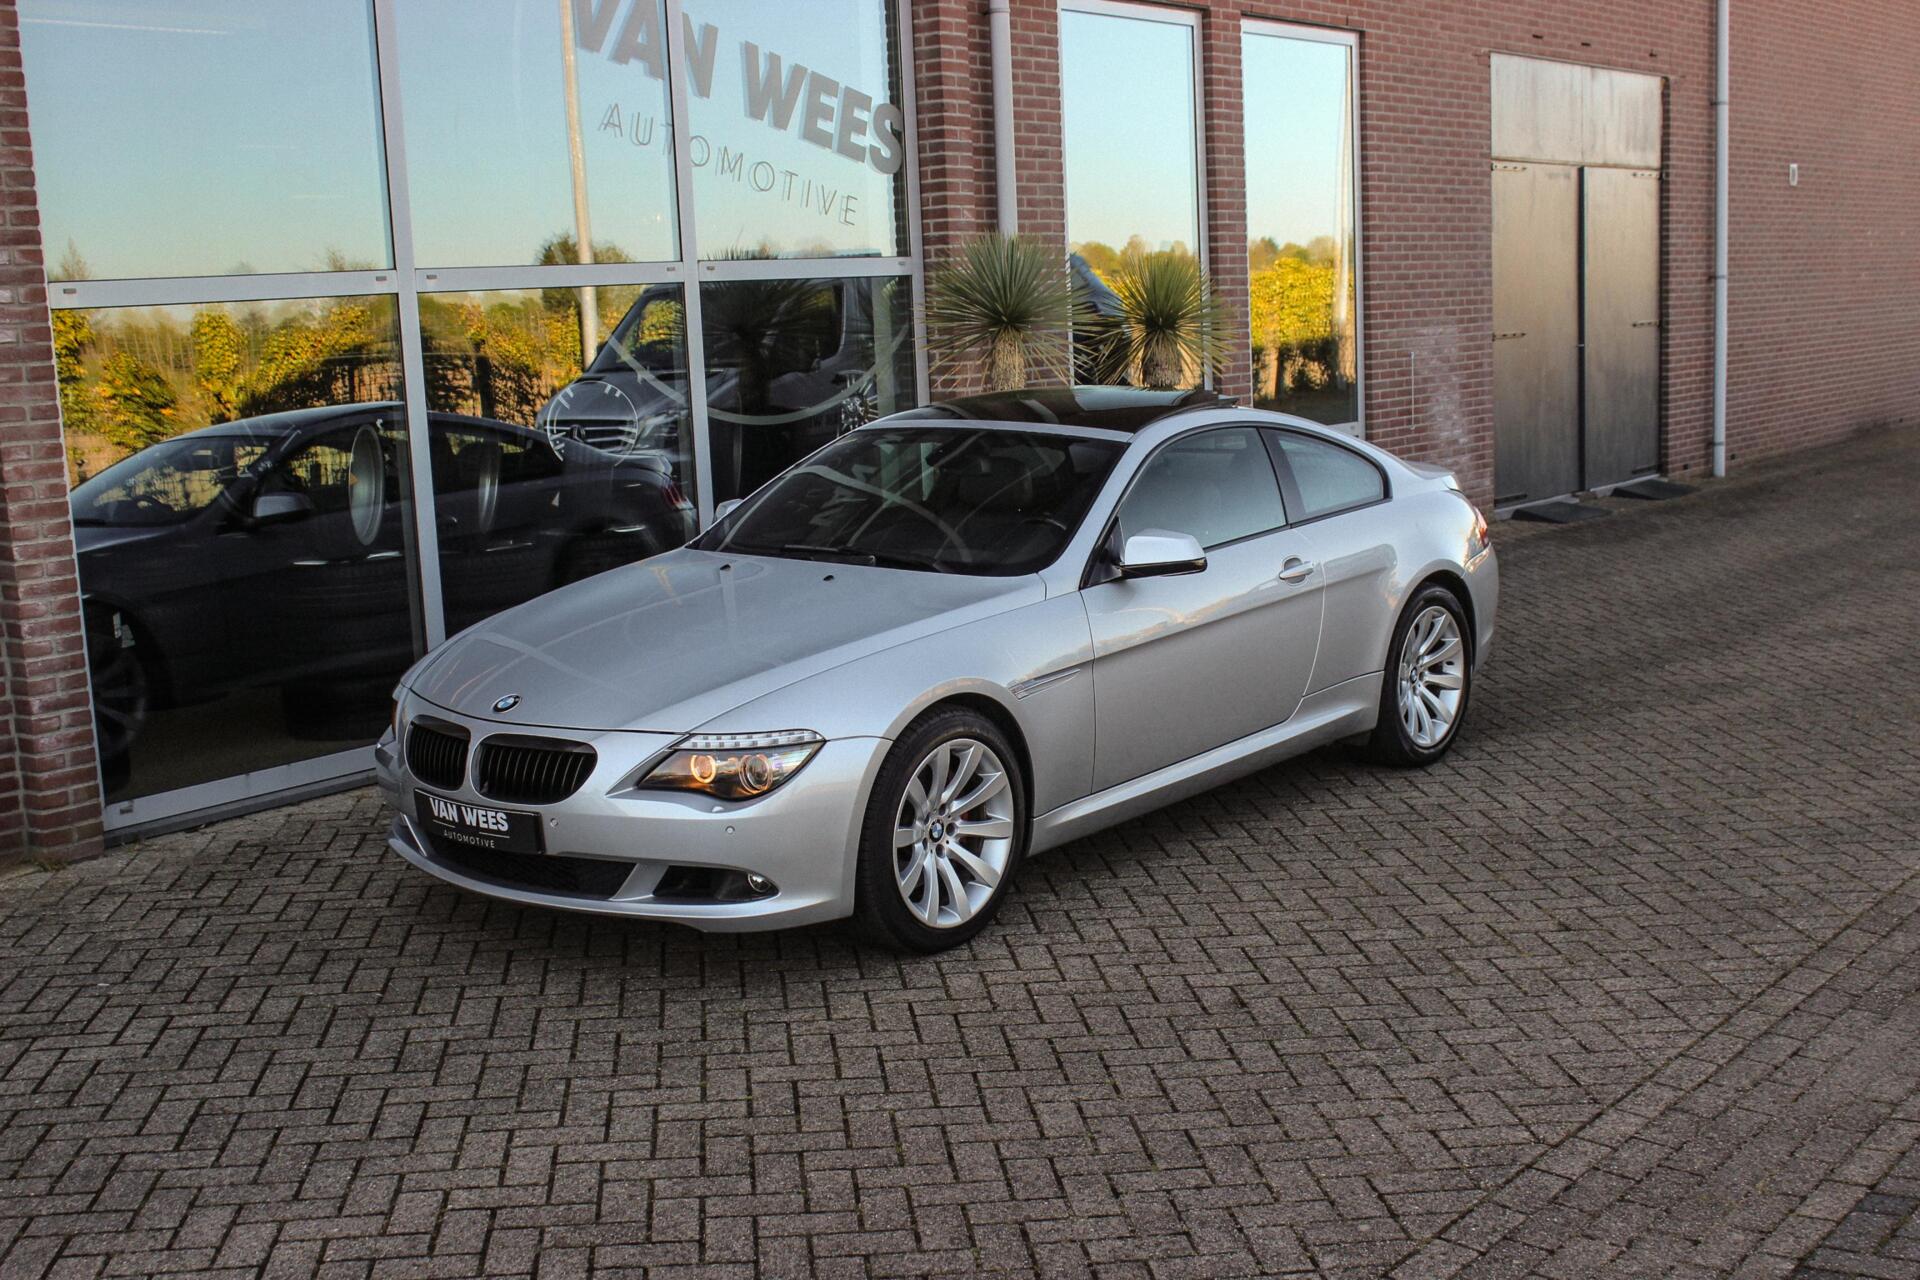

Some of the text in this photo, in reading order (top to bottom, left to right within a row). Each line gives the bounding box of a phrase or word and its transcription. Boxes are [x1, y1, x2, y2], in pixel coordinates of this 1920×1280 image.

[574, 0, 903, 175] VAN WEES
[429, 797, 509, 832] VAN WEES
[443, 829, 496, 849] AUTOMOTIVE
